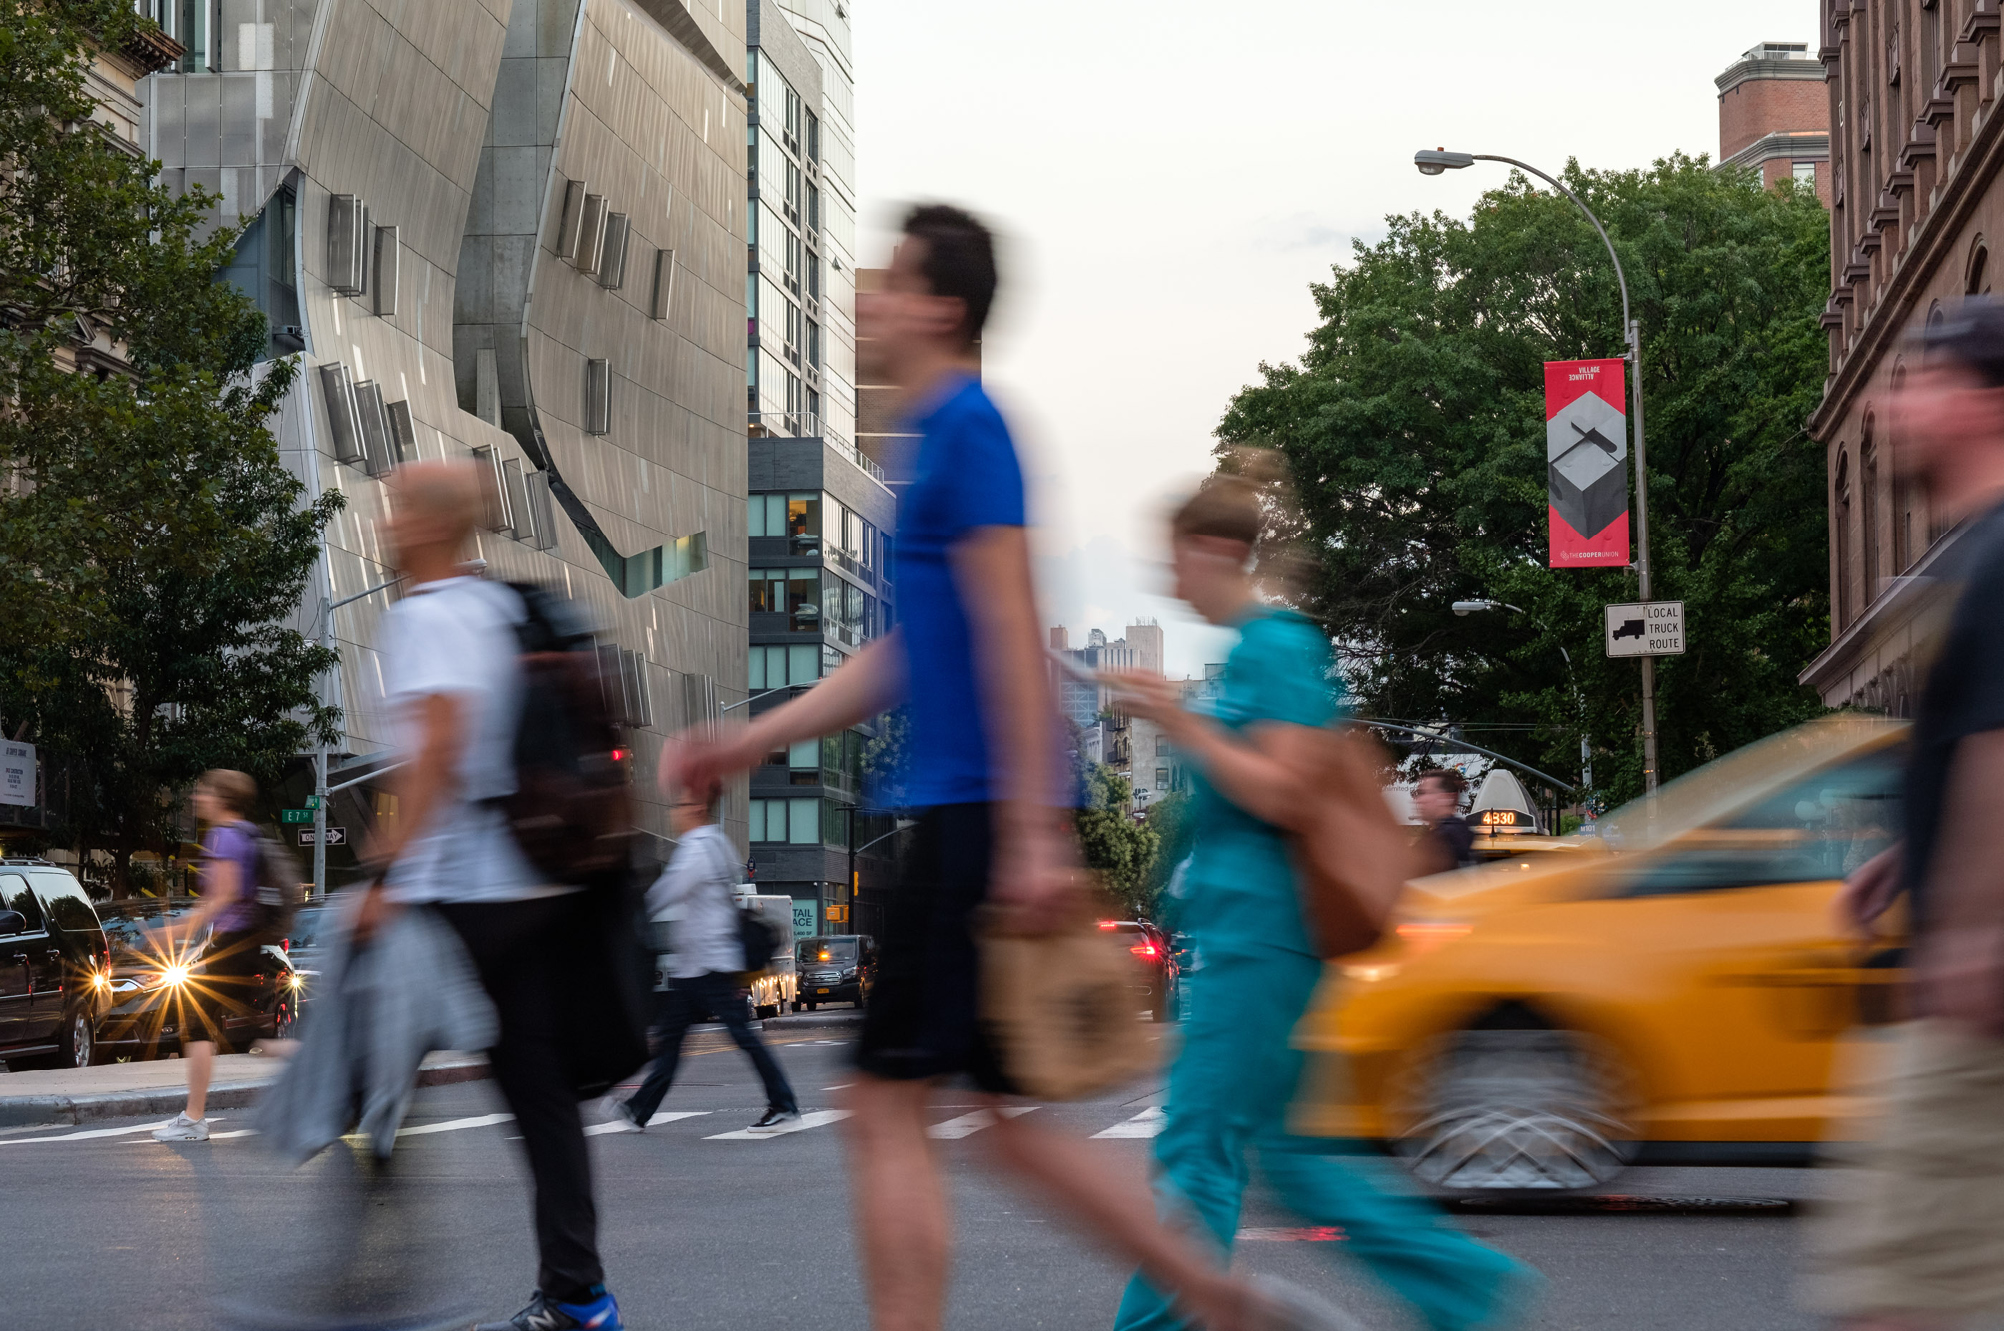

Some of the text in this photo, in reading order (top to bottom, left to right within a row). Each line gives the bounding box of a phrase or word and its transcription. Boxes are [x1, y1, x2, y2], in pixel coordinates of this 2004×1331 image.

[1648, 607, 1678, 618] LOCAL
[1649, 623, 1678, 633] TRUCK
[1650, 638, 1679, 649] ROUTE
[288, 811, 292, 821] E
[296, 811, 300, 821] 7
[792, 909, 813, 917] TAIL
[793, 918, 812, 926] ACE
